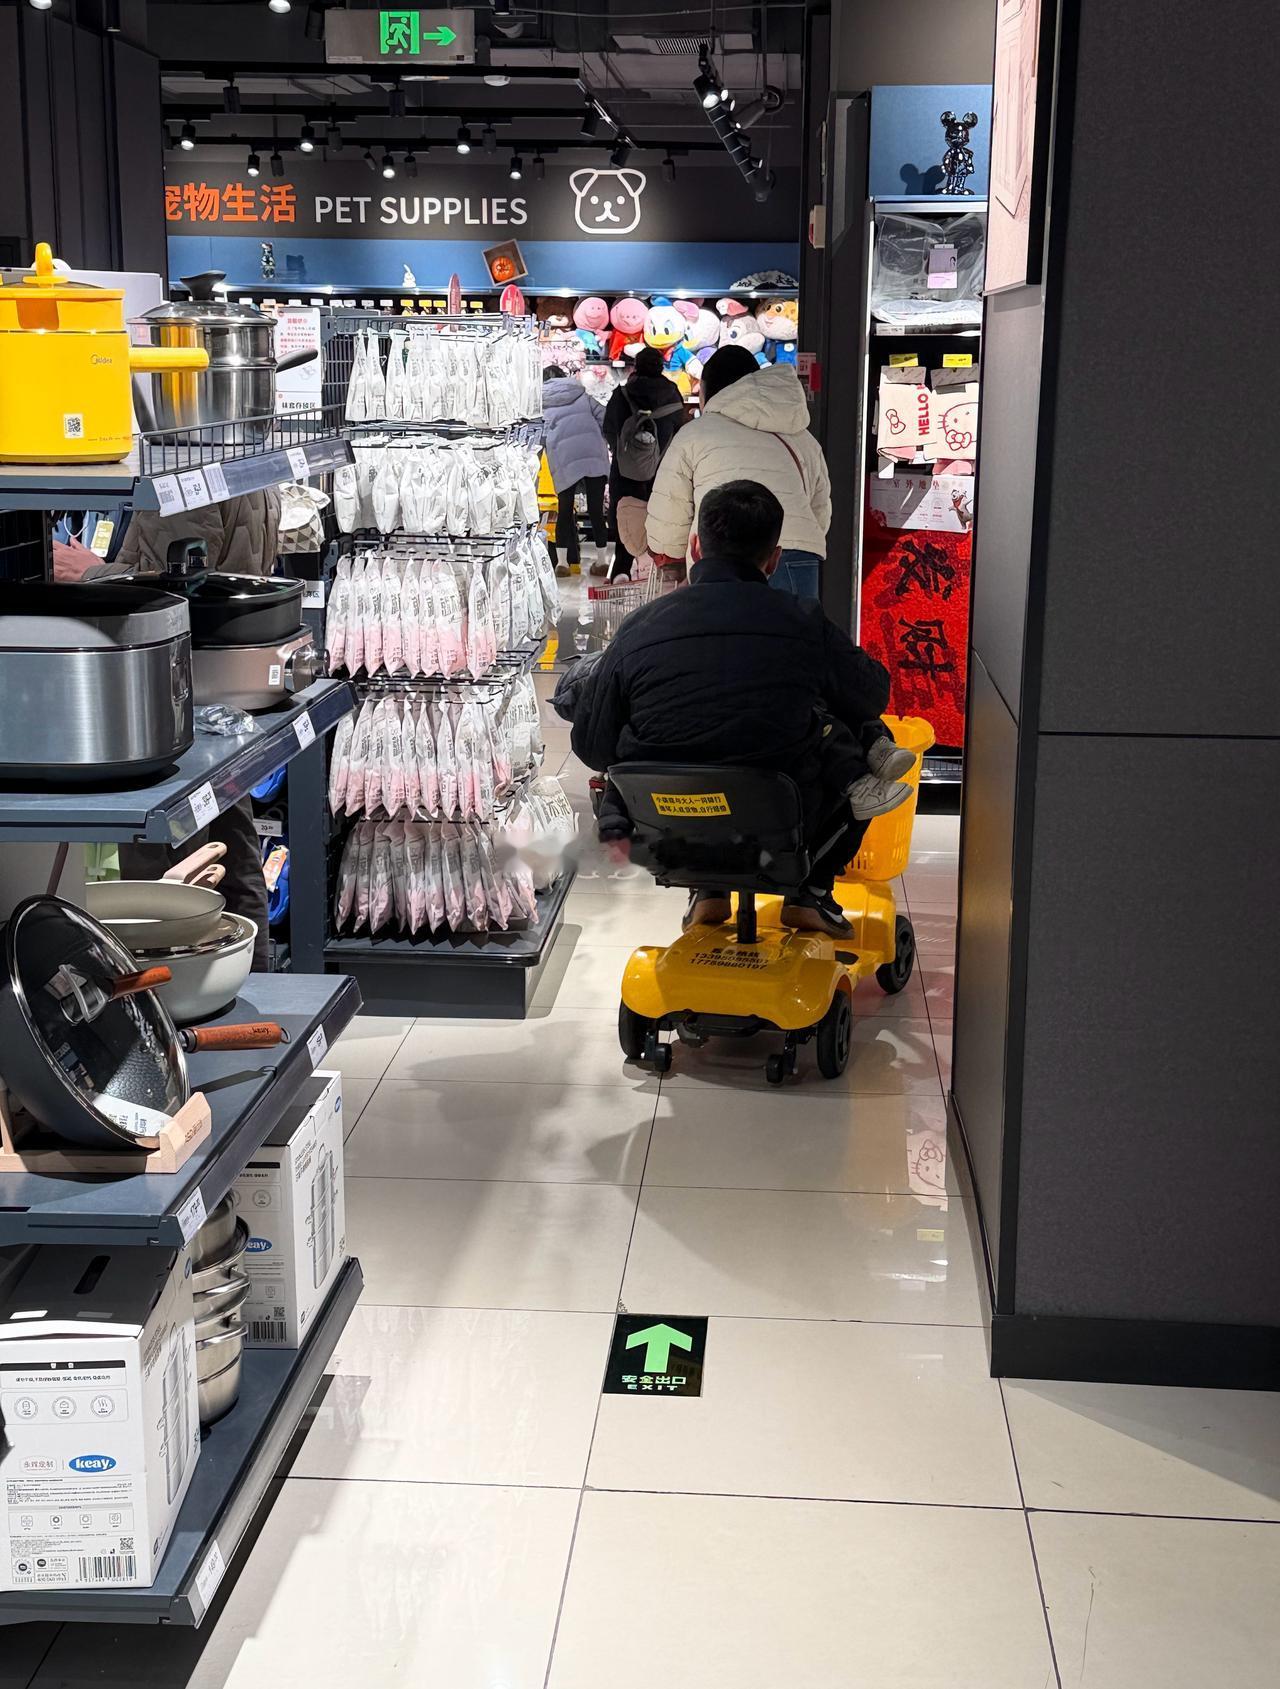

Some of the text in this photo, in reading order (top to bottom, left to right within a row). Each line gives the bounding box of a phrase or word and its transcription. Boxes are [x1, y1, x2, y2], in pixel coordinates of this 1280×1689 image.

[314, 196, 528, 225] PET SUPPLIES
[917, 393, 930, 436] HELLO
[621, 1374, 687, 1385] 安全出口
[626, 1383, 678, 1391] EXIT
